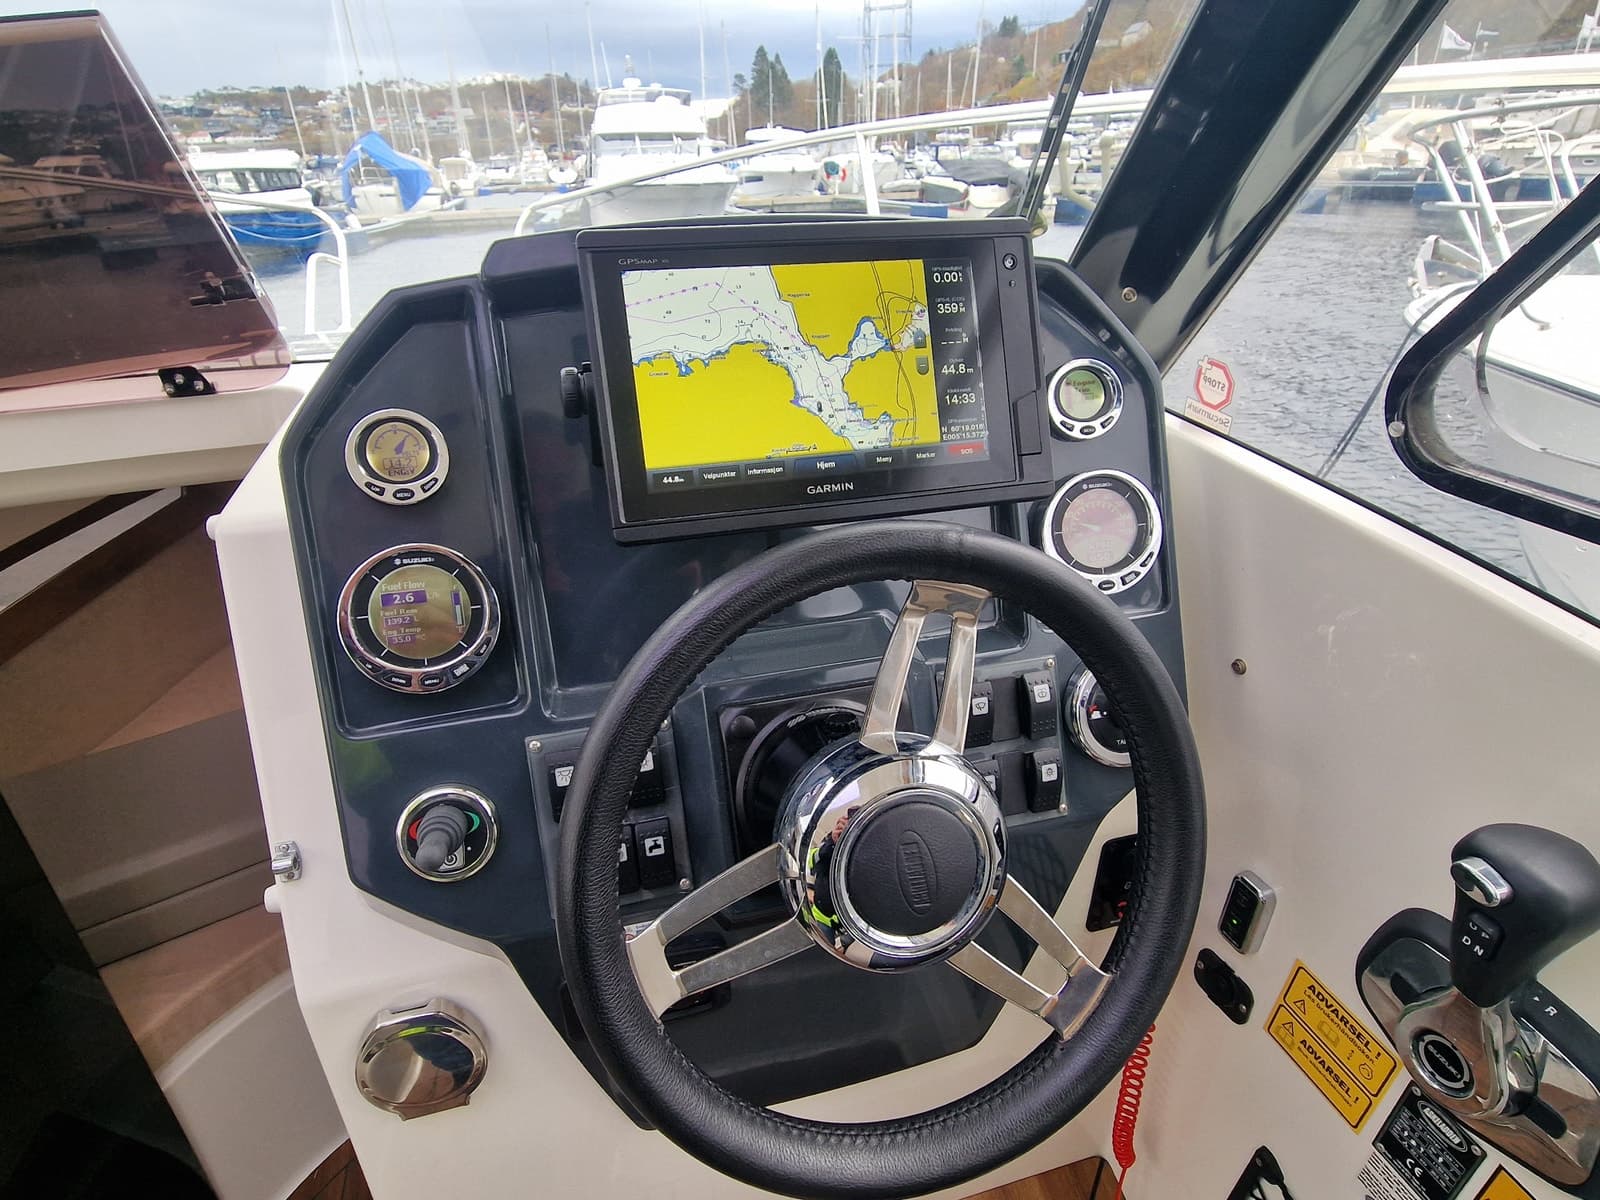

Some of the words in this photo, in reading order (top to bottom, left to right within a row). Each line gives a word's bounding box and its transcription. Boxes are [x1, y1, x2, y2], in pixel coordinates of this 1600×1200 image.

[933, 271, 958, 283] 0.00
[937, 302, 958, 314] 359
[941, 363, 966, 375] 44.8
[945, 392, 976, 405] 14:33
[816, 460, 836, 471] Hjem
[876, 455, 893, 464] Meny
[807, 482, 854, 495] GARMIN
[381, 582, 401, 592] Fuel
[403, 580, 425, 589] Flow
[392, 594, 415, 604] 2.6
[1461, 935, 1471, 946] D
[1473, 945, 1484, 956] N
[1307, 984, 1372, 1052] ADVARSEL
[1544, 1006, 1558, 1018] R
[1427, 1044, 1462, 1079] SUZUKI
[1299, 1039, 1352, 1098] ADVARSEL
[1406, 1157, 1424, 1178] CE
